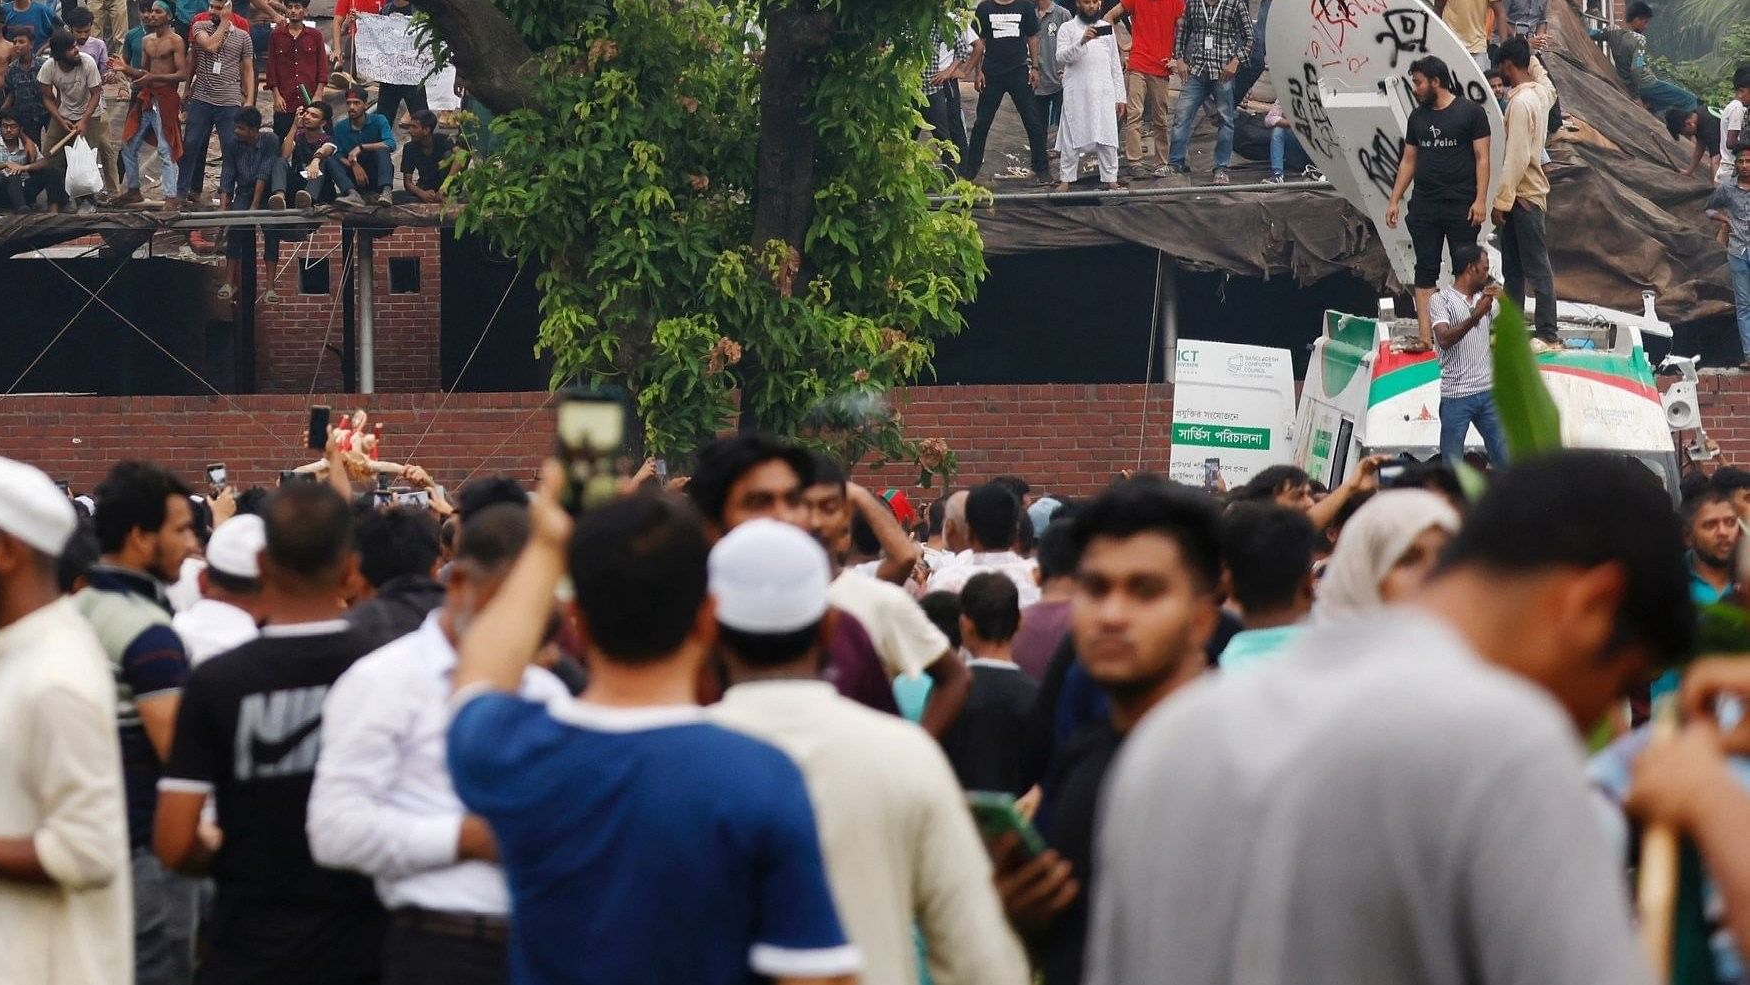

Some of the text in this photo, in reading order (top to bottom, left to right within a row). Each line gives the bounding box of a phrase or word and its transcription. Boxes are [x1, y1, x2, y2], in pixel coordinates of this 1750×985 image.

[1177, 350, 1199, 362] ICT
[1178, 426, 1263, 445] সার্ভিস পরিচালনা
